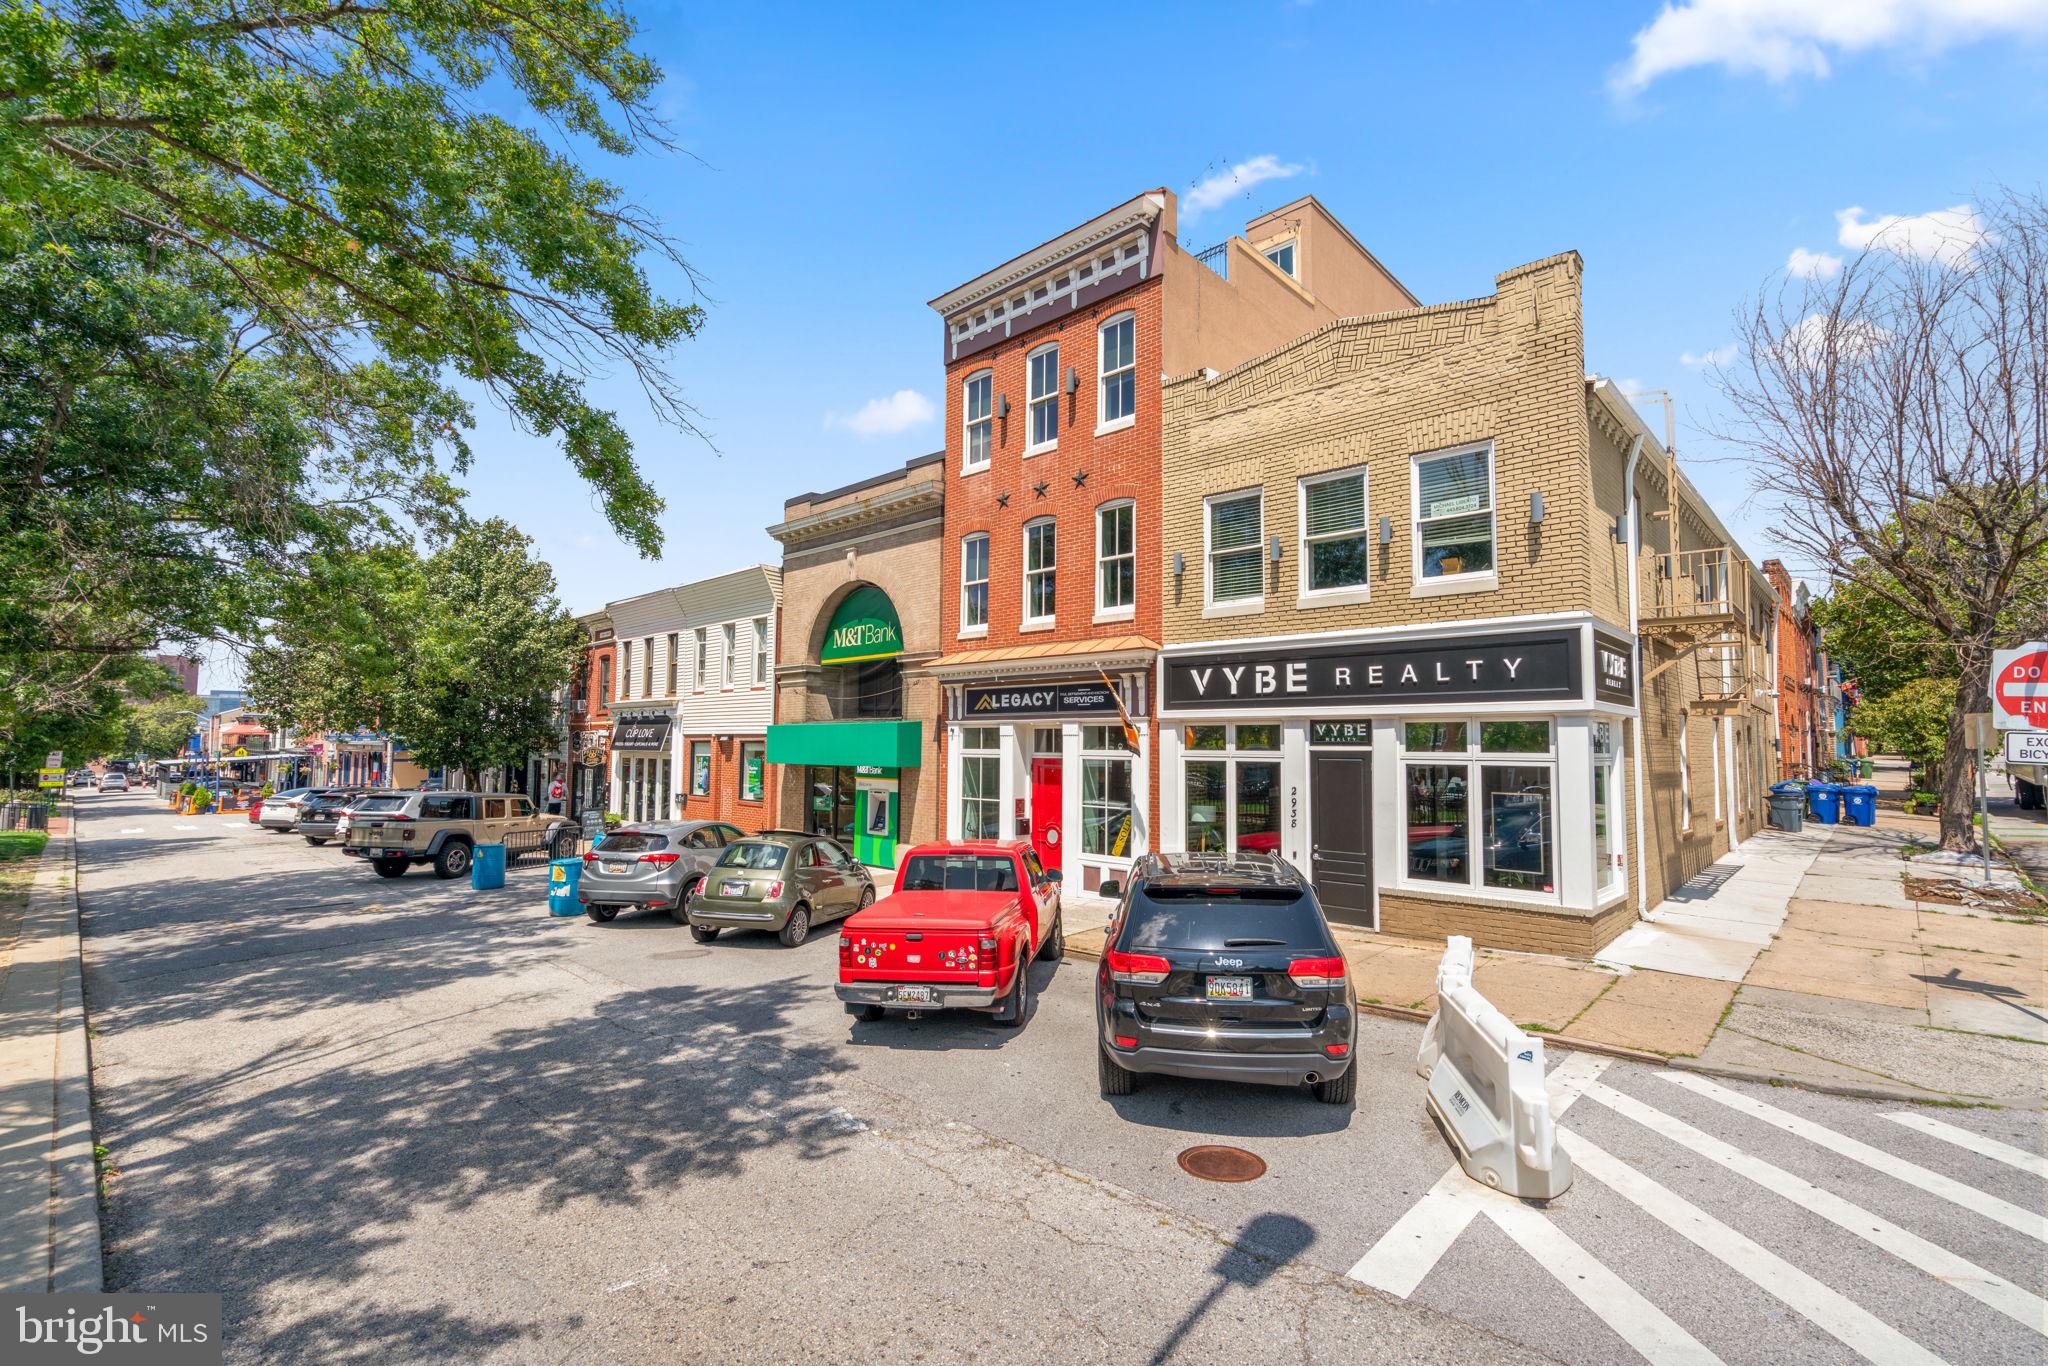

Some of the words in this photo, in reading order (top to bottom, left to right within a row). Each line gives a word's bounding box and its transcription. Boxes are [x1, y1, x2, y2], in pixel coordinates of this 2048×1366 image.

[833, 625, 865, 648] M&T
[865, 620, 896, 644] Bank
[1190, 662, 1308, 696] VYBE
[1335, 657, 1522, 687] REALTY
[2013, 666, 2041, 678] DO
[992, 691, 1055, 708] LEGACY
[1063, 695, 1105, 704] SERVICES
[2020, 701, 2046, 713] EN
[638, 728, 655, 738] LOVE
[1316, 723, 1367, 736] VYBE
[1214, 956, 1243, 968] Jeep
